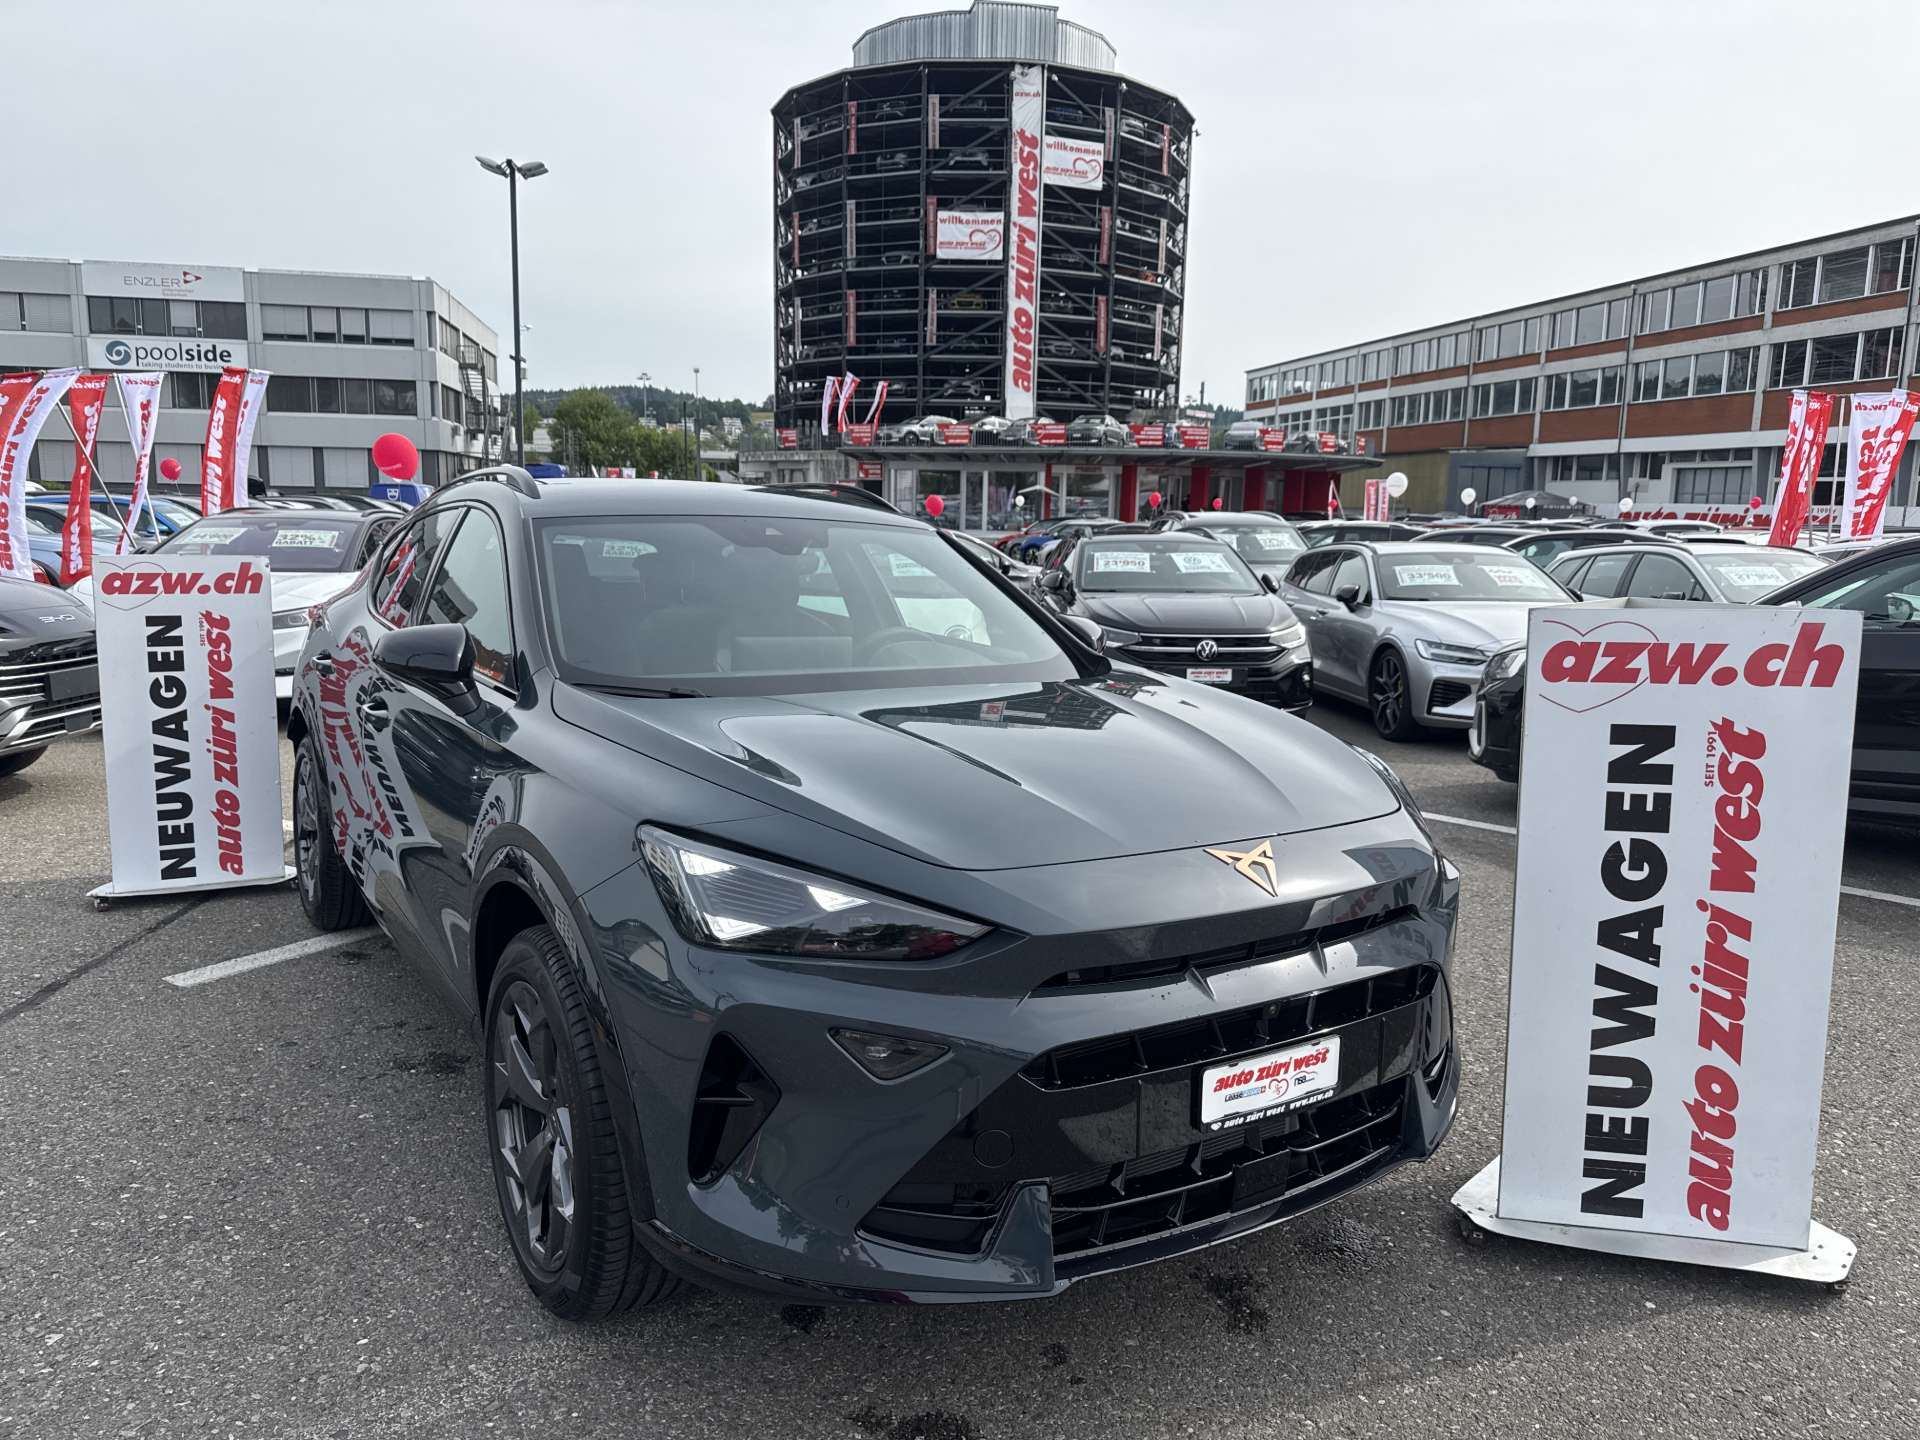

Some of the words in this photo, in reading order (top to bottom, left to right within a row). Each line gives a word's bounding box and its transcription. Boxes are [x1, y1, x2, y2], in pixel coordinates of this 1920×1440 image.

[1016, 128, 1039, 218] west
[1045, 141, 1102, 156] willkommen
[938, 215, 1003, 226] willkommen
[123, 275, 181, 288] ENZLER
[1011, 222, 1036, 306] züri
[135, 342, 232, 366] poolside
[141, 361, 163, 369] taking
[1010, 307, 1033, 393] auto
[206, 395, 227, 459] west
[101, 561, 264, 596] azw.ch
[202, 609, 234, 700] west
[1541, 622, 1845, 688] azw.ch
[145, 615, 197, 881] NEUWAGEN
[204, 703, 239, 788] züri
[1703, 764, 1715, 788] SEIT
[1705, 731, 1717, 760] 1991
[211, 788, 243, 876] auto
[1709, 715, 1768, 894] west
[1579, 723, 1677, 1219] NEUWAGEN
[1688, 898, 1753, 1067] züri
[1213, 1069, 1255, 1093] auto
[1255, 1057, 1293, 1082] züri
[1293, 1047, 1330, 1072] west
[1223, 1116, 1244, 1129] auto
[1246, 1110, 1265, 1123] züri
[1266, 1104, 1286, 1117] west
[1682, 1063, 1740, 1232] auto
